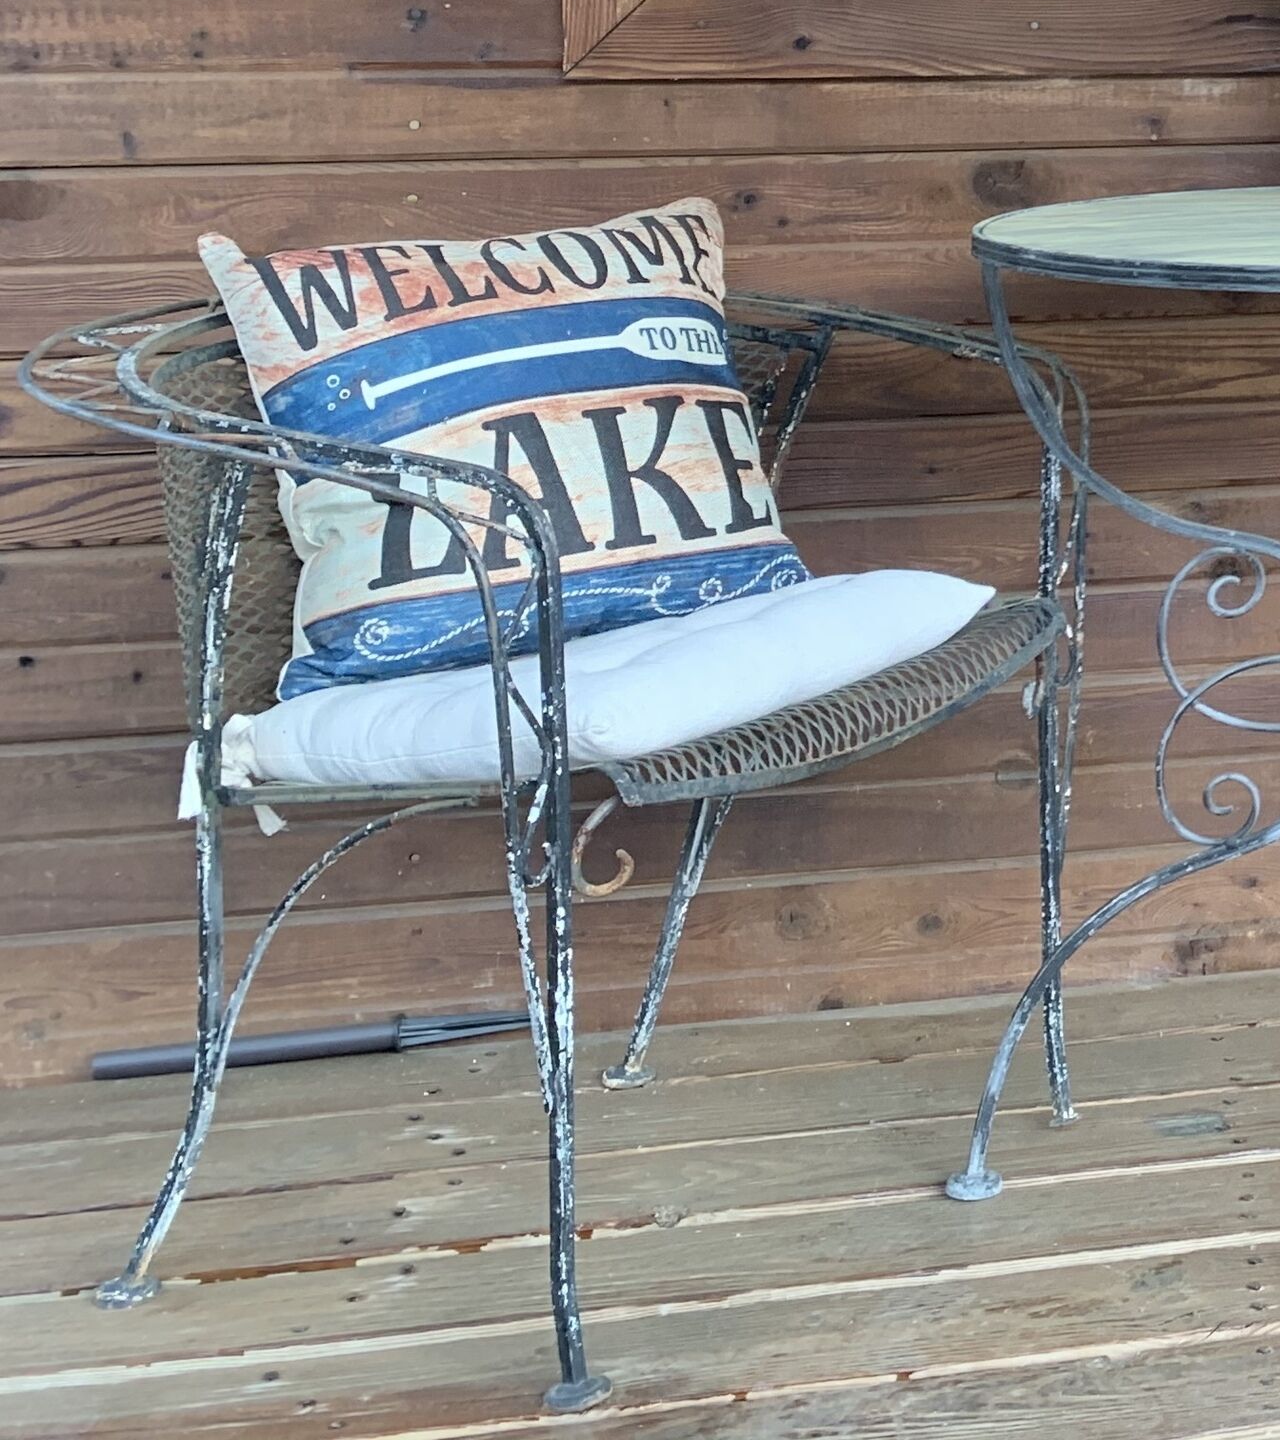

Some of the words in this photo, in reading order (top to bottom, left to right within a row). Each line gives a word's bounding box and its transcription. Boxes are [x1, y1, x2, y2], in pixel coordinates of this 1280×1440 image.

[244, 213, 717, 351] WELCOME
[639, 326, 677, 350] TO
[367, 395, 774, 591] LAKE
